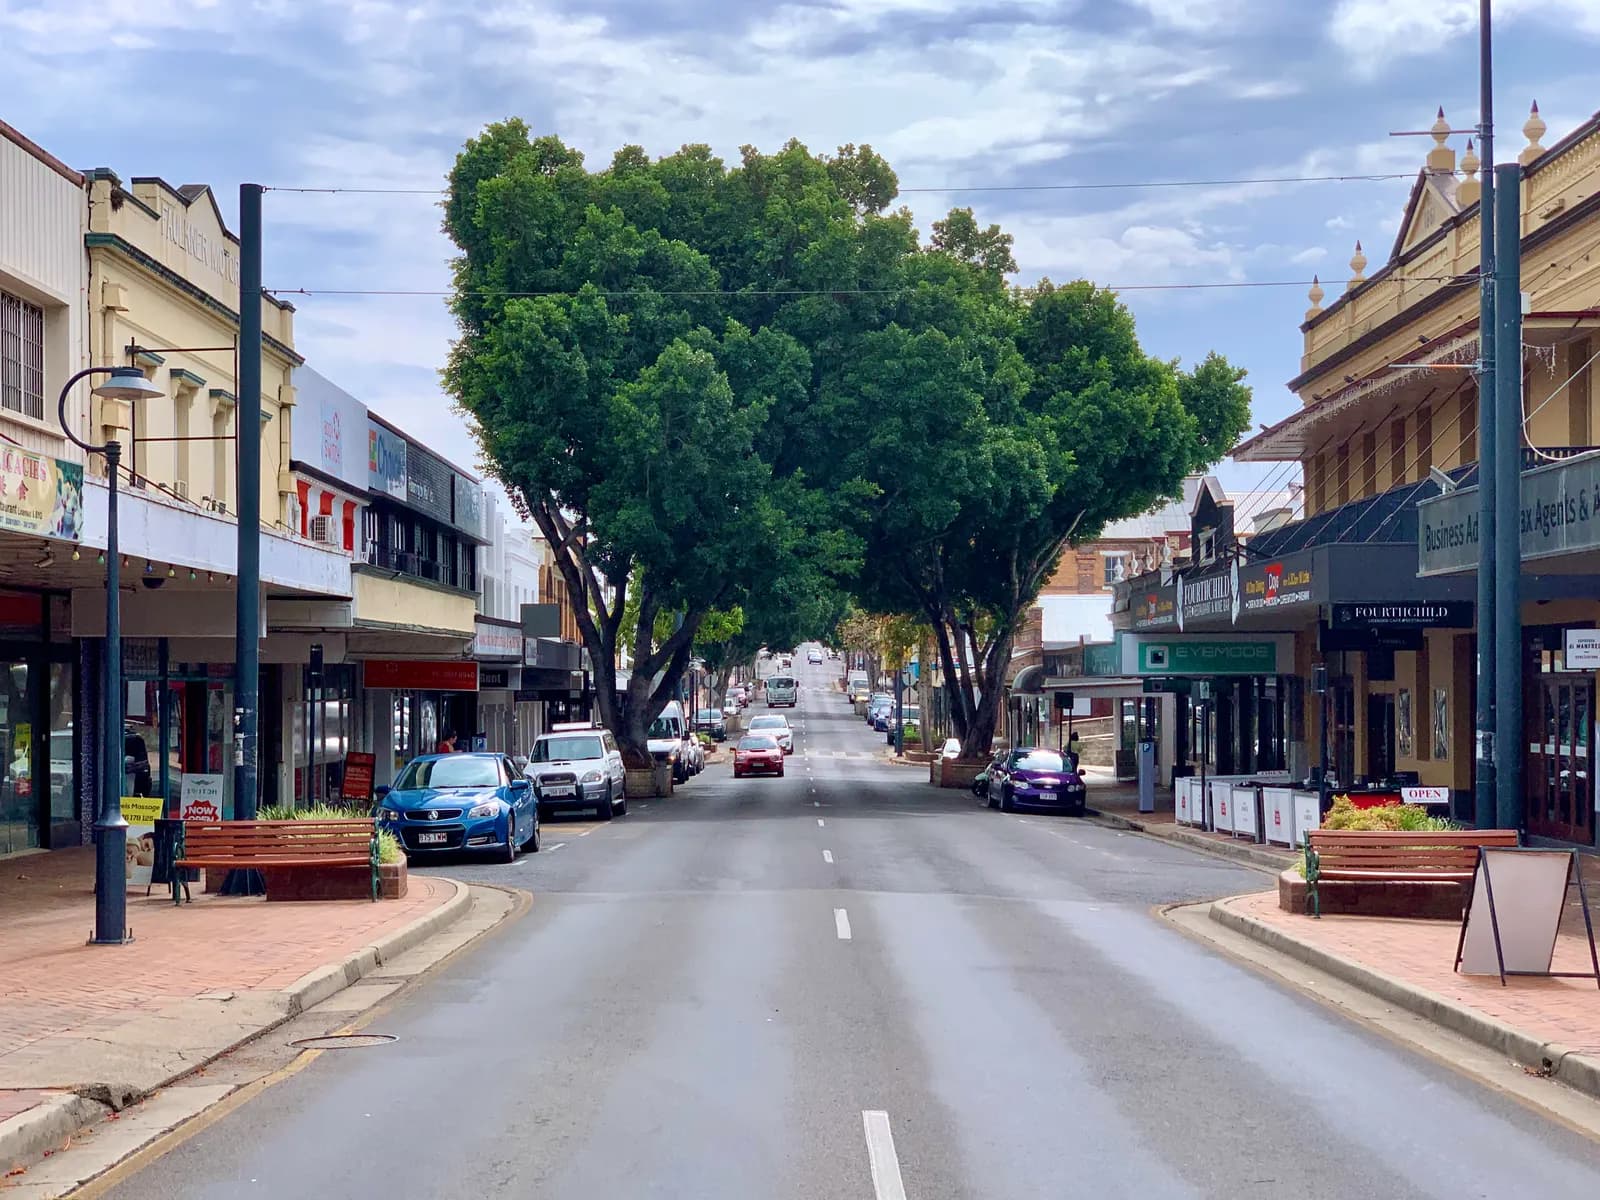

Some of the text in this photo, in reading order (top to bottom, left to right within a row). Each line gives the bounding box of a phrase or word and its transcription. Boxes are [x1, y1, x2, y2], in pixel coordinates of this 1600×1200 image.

[1425, 520, 1464, 552] Business
[1534, 493, 1576, 537] Agents
[1578, 489, 1589, 521] &
[1184, 575, 1230, 606] FOURTHCHILD
[1355, 607, 1448, 617] FOURTHCHILD
[1176, 646, 1270, 658] EYEMODE
[1409, 790, 1441, 798] OPEN
[131, 803, 160, 812] Massage
[188, 806, 215, 815] NOW
